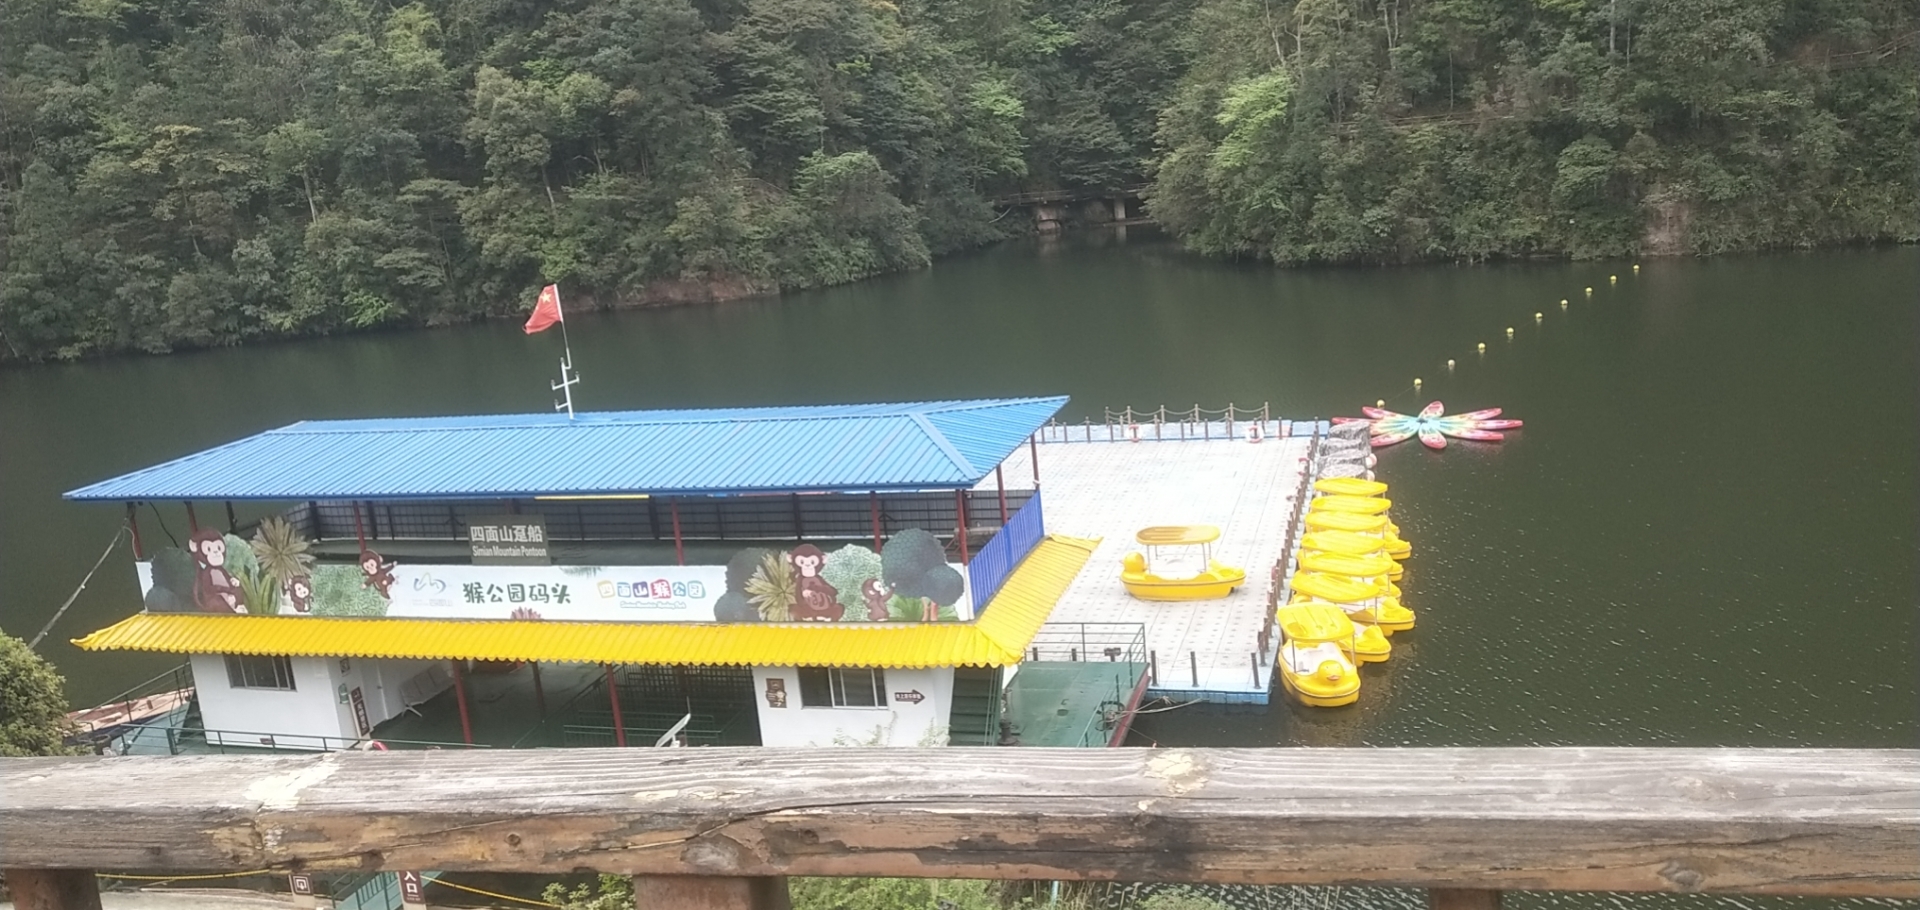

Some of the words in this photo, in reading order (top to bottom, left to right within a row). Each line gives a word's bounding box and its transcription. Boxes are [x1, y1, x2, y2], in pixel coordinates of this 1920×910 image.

[472, 545, 493, 556] Simian
[493, 545, 520, 556] Mountain
[520, 545, 547, 556] Pontoon
[463, 582, 571, 604] 猴公园码头
[404, 871, 418, 893] 入口
